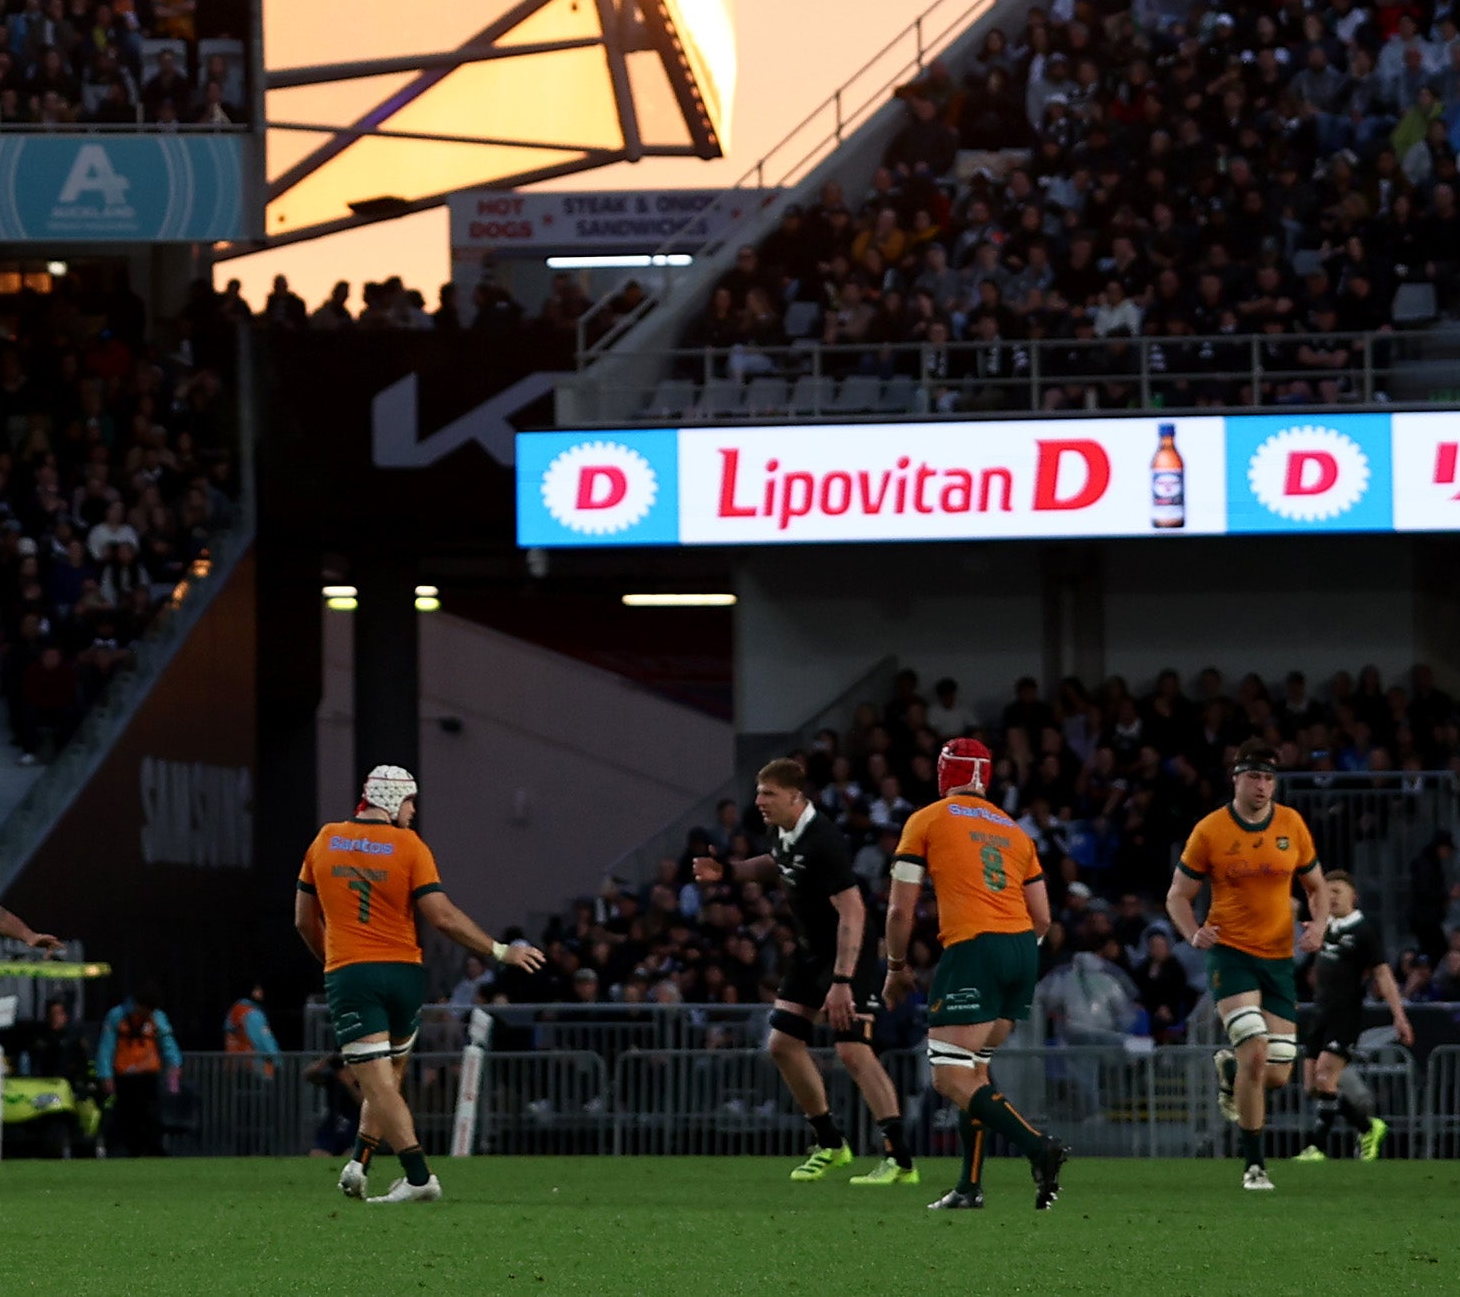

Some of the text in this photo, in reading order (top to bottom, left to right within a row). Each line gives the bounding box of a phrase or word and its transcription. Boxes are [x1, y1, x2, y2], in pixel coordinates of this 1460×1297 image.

[478, 197, 525, 216] HOT
[469, 220, 532, 239] DOGS
[576, 466, 628, 511] D
[718, 448, 1013, 530] Lipovitan
[1032, 439, 1112, 512] D
[1284, 451, 1339, 496] D
[329, 835, 395, 857] Santos
[980, 845, 1006, 893] 8
[349, 881, 372, 923] 7
